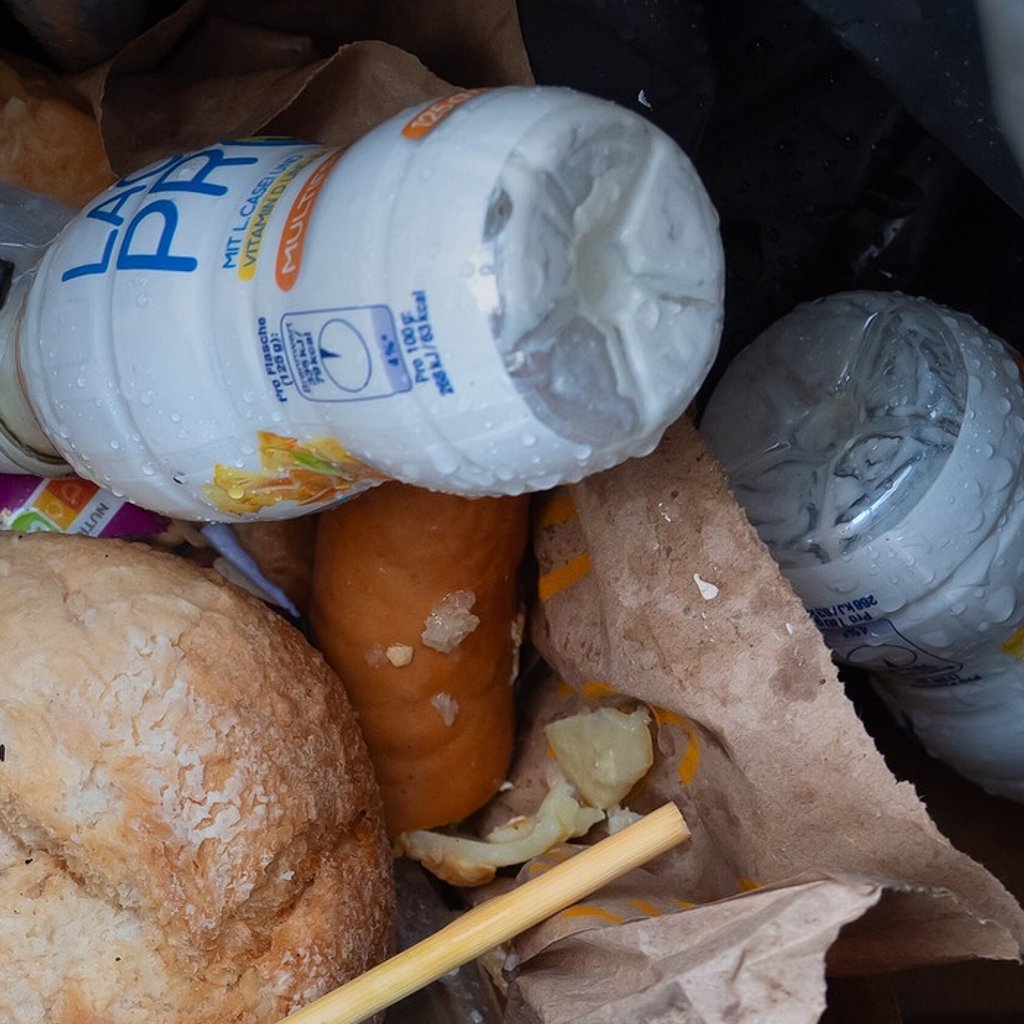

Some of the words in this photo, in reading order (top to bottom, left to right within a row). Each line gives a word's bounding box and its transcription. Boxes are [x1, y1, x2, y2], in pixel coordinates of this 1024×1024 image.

[117, 139, 311, 271] PR
[242, 193, 277, 267] VITAMIN
[222, 236, 241, 269] MIT
[257, 316, 277, 376] Flasche
[848, 610, 873, 623] Pro
